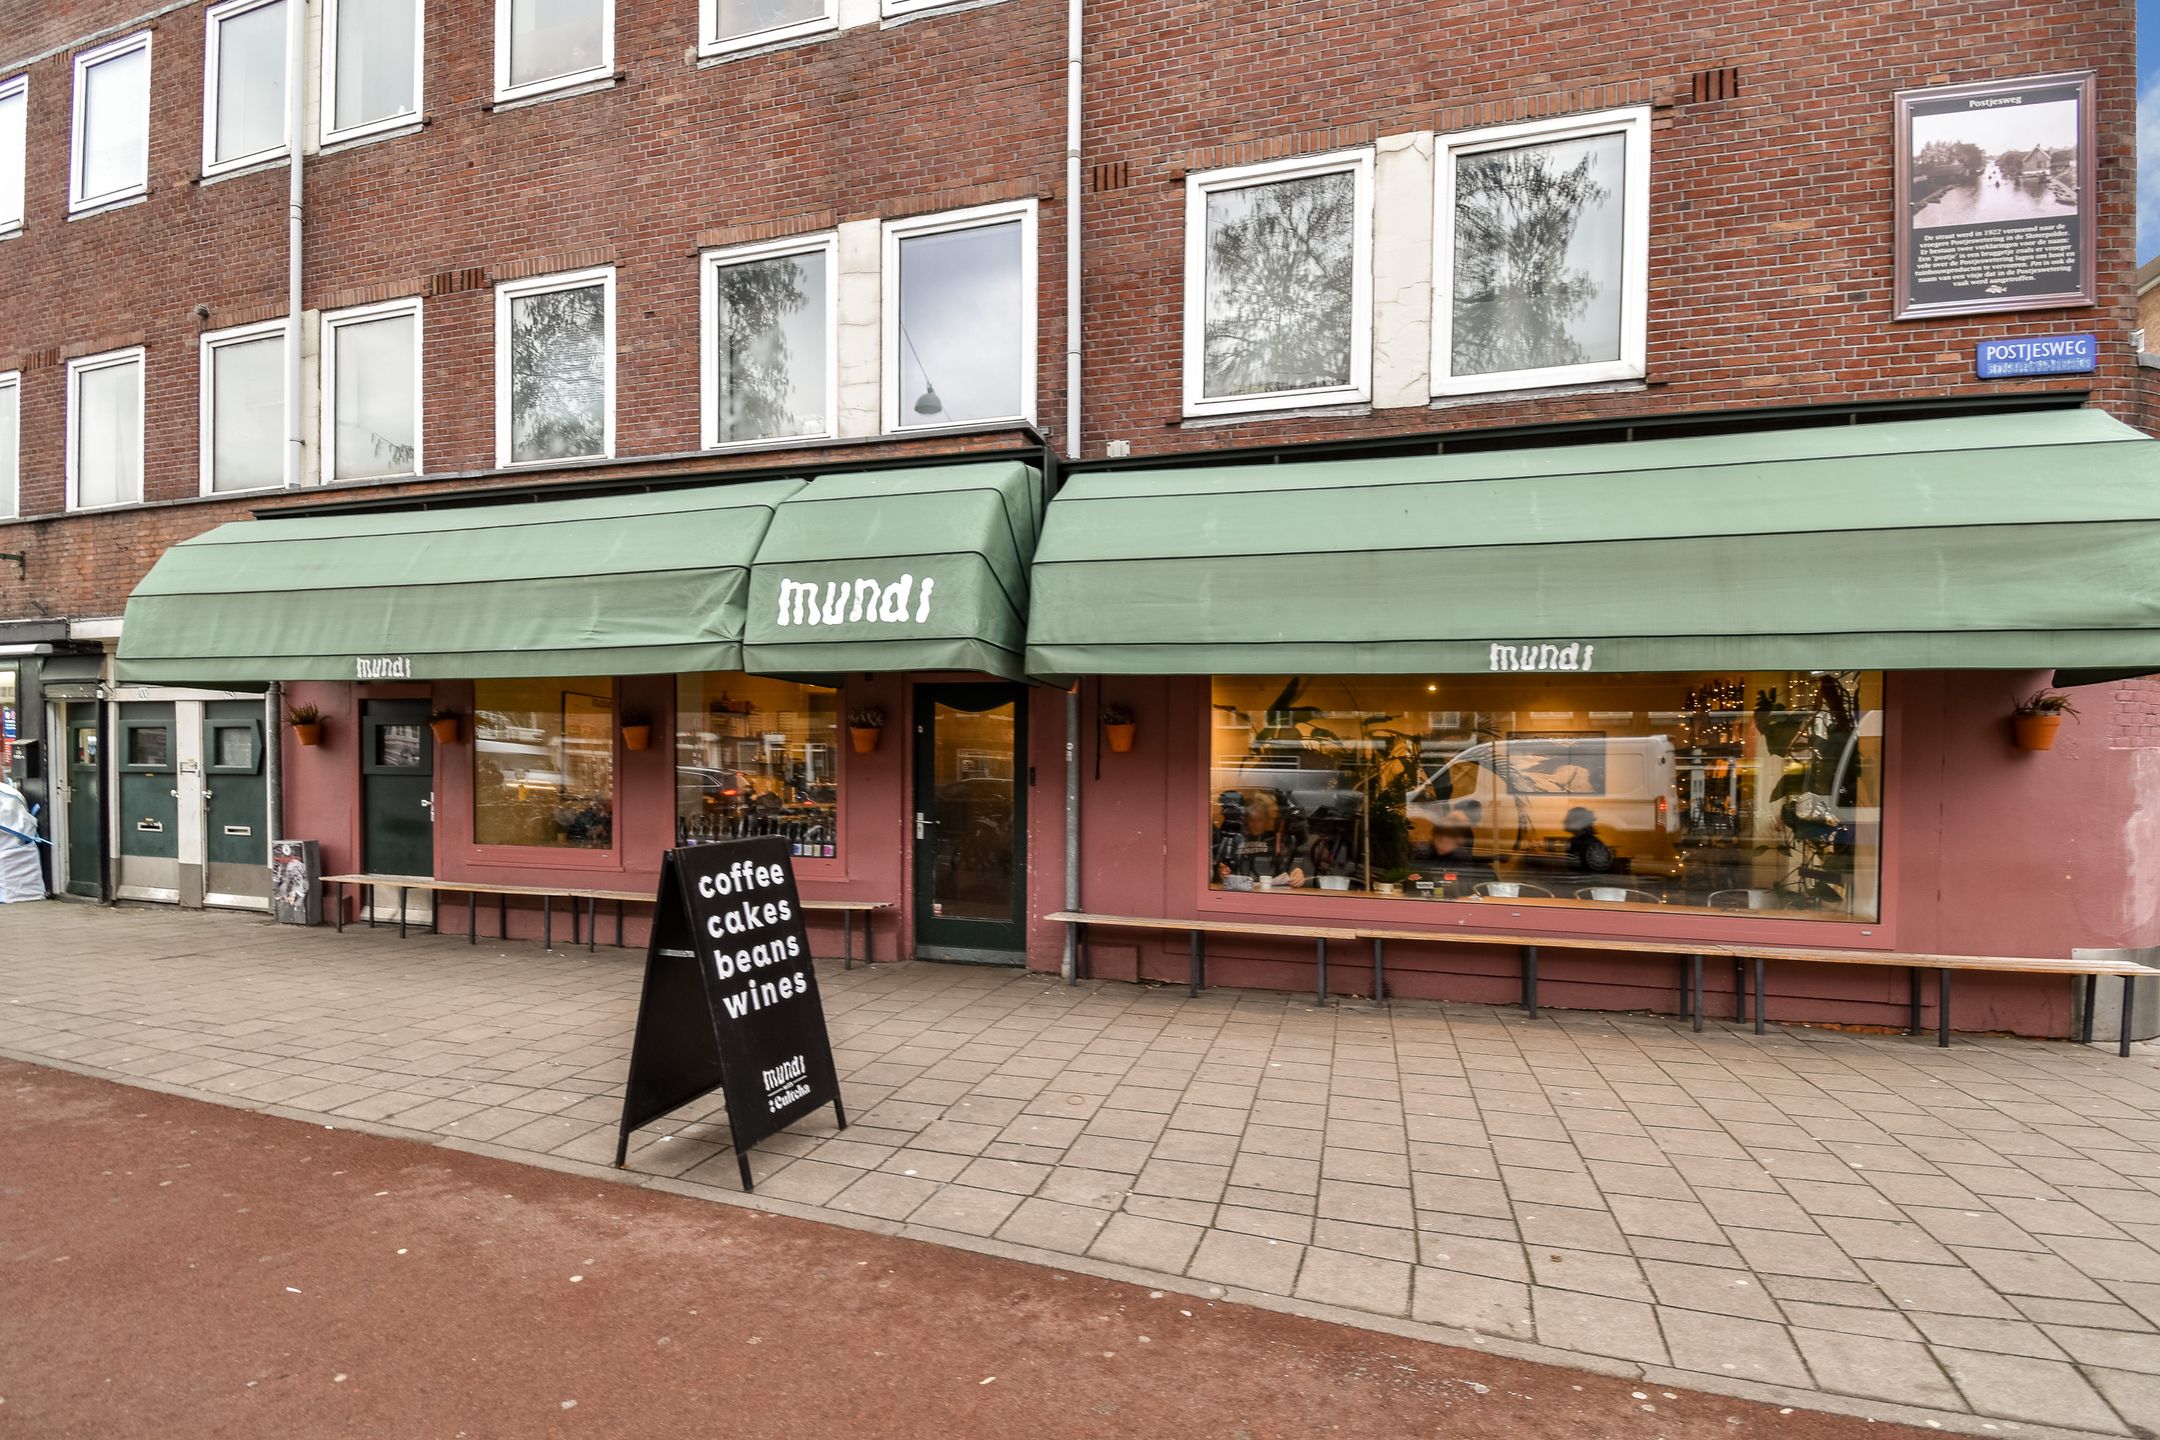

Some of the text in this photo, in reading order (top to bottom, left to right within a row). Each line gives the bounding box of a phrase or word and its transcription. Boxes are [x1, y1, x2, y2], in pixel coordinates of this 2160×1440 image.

[1969, 96, 2022, 107] Postjesweg
[1951, 237, 2004, 245] Postjeswetering
[2025, 231, 2070, 239] Sloterpolder.
[2003, 226, 2038, 234] vernoemd
[1975, 242, 2018, 250] verklaringen
[1960, 257, 2014, 265] Postjeswetering
[2017, 266, 2072, 274] Postjeswetering
[1987, 340, 2087, 361] POSTJESWEG
[777, 574, 934, 627] mundi
[356, 656, 411, 678] mundi
[1489, 643, 1594, 670] mundi
[699, 860, 785, 899] coffee
[707, 898, 792, 939] cakes
[714, 935, 800, 980] beans
[723, 971, 808, 1020] wines
[762, 1055, 806, 1091] mundi
